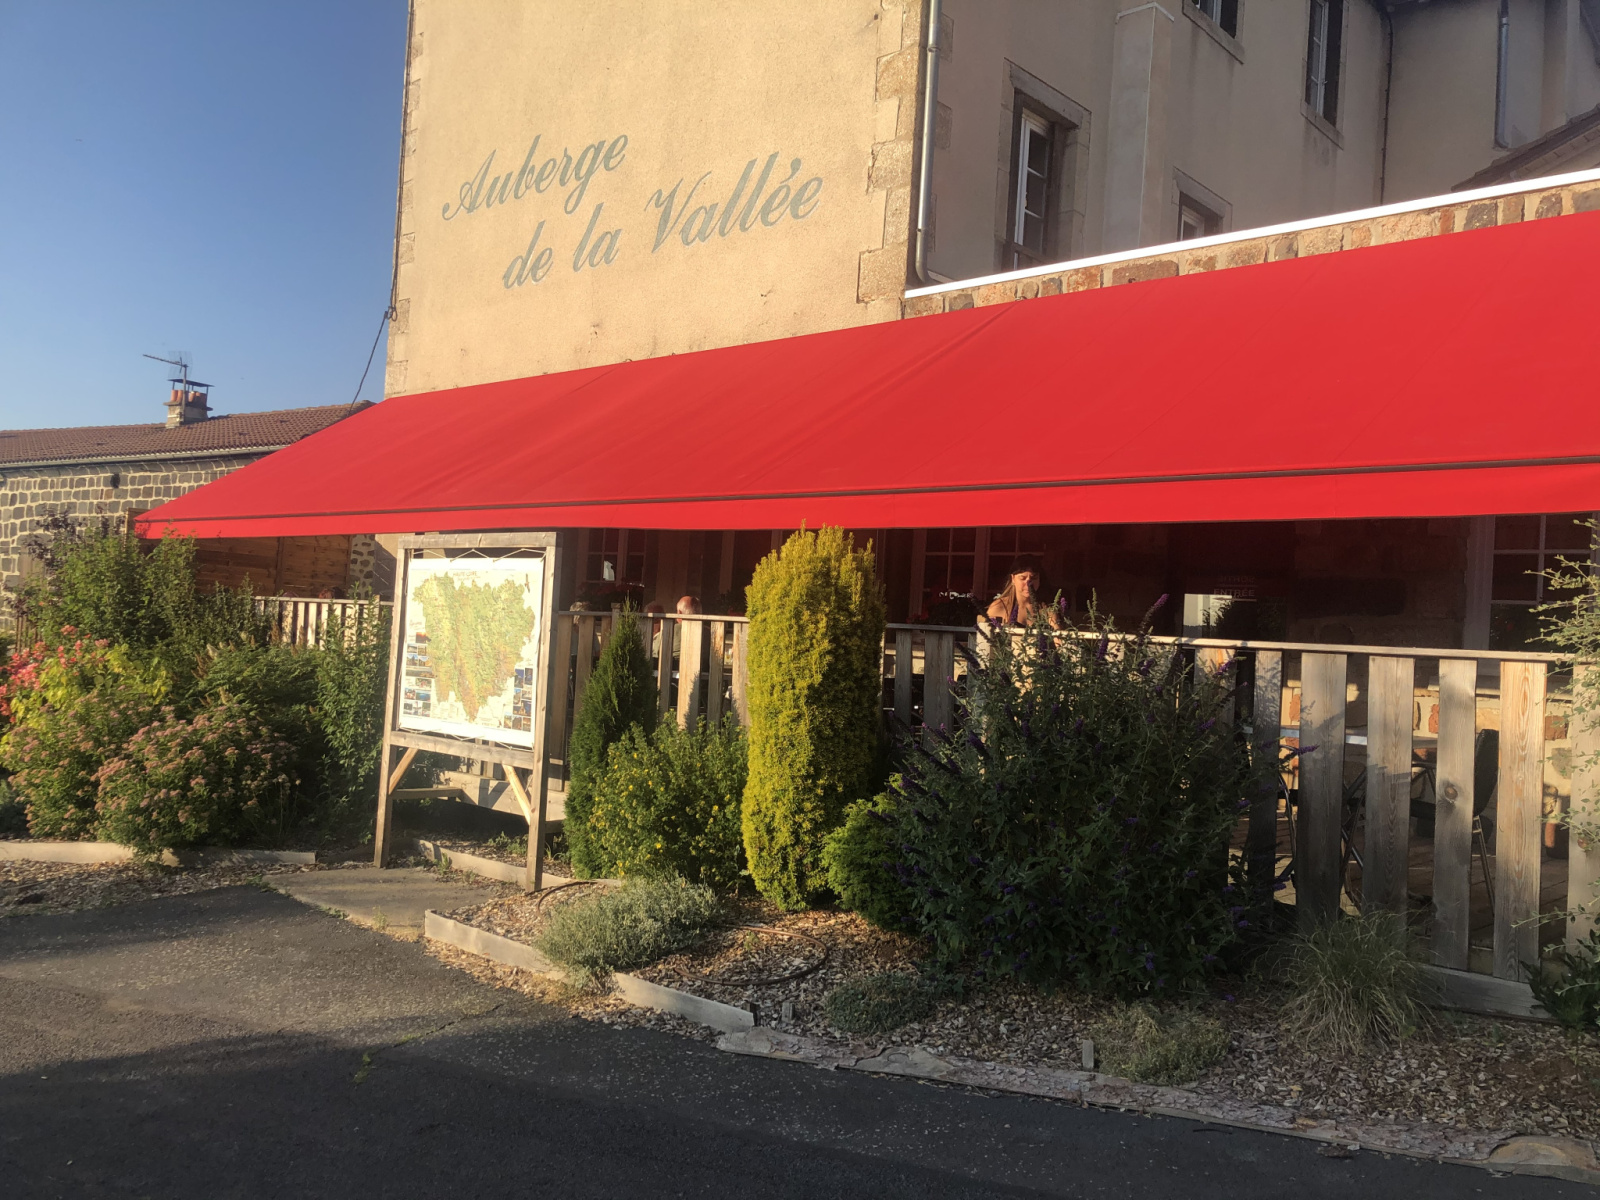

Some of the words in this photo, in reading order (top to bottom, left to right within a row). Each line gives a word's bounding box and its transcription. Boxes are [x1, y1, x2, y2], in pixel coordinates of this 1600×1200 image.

[442, 134, 628, 221] Auberge
[502, 220, 553, 289] de
[573, 202, 622, 272] la
[644, 151, 823, 254] Vallée
[1214, 588, 1255, 597] ENTRÉE
